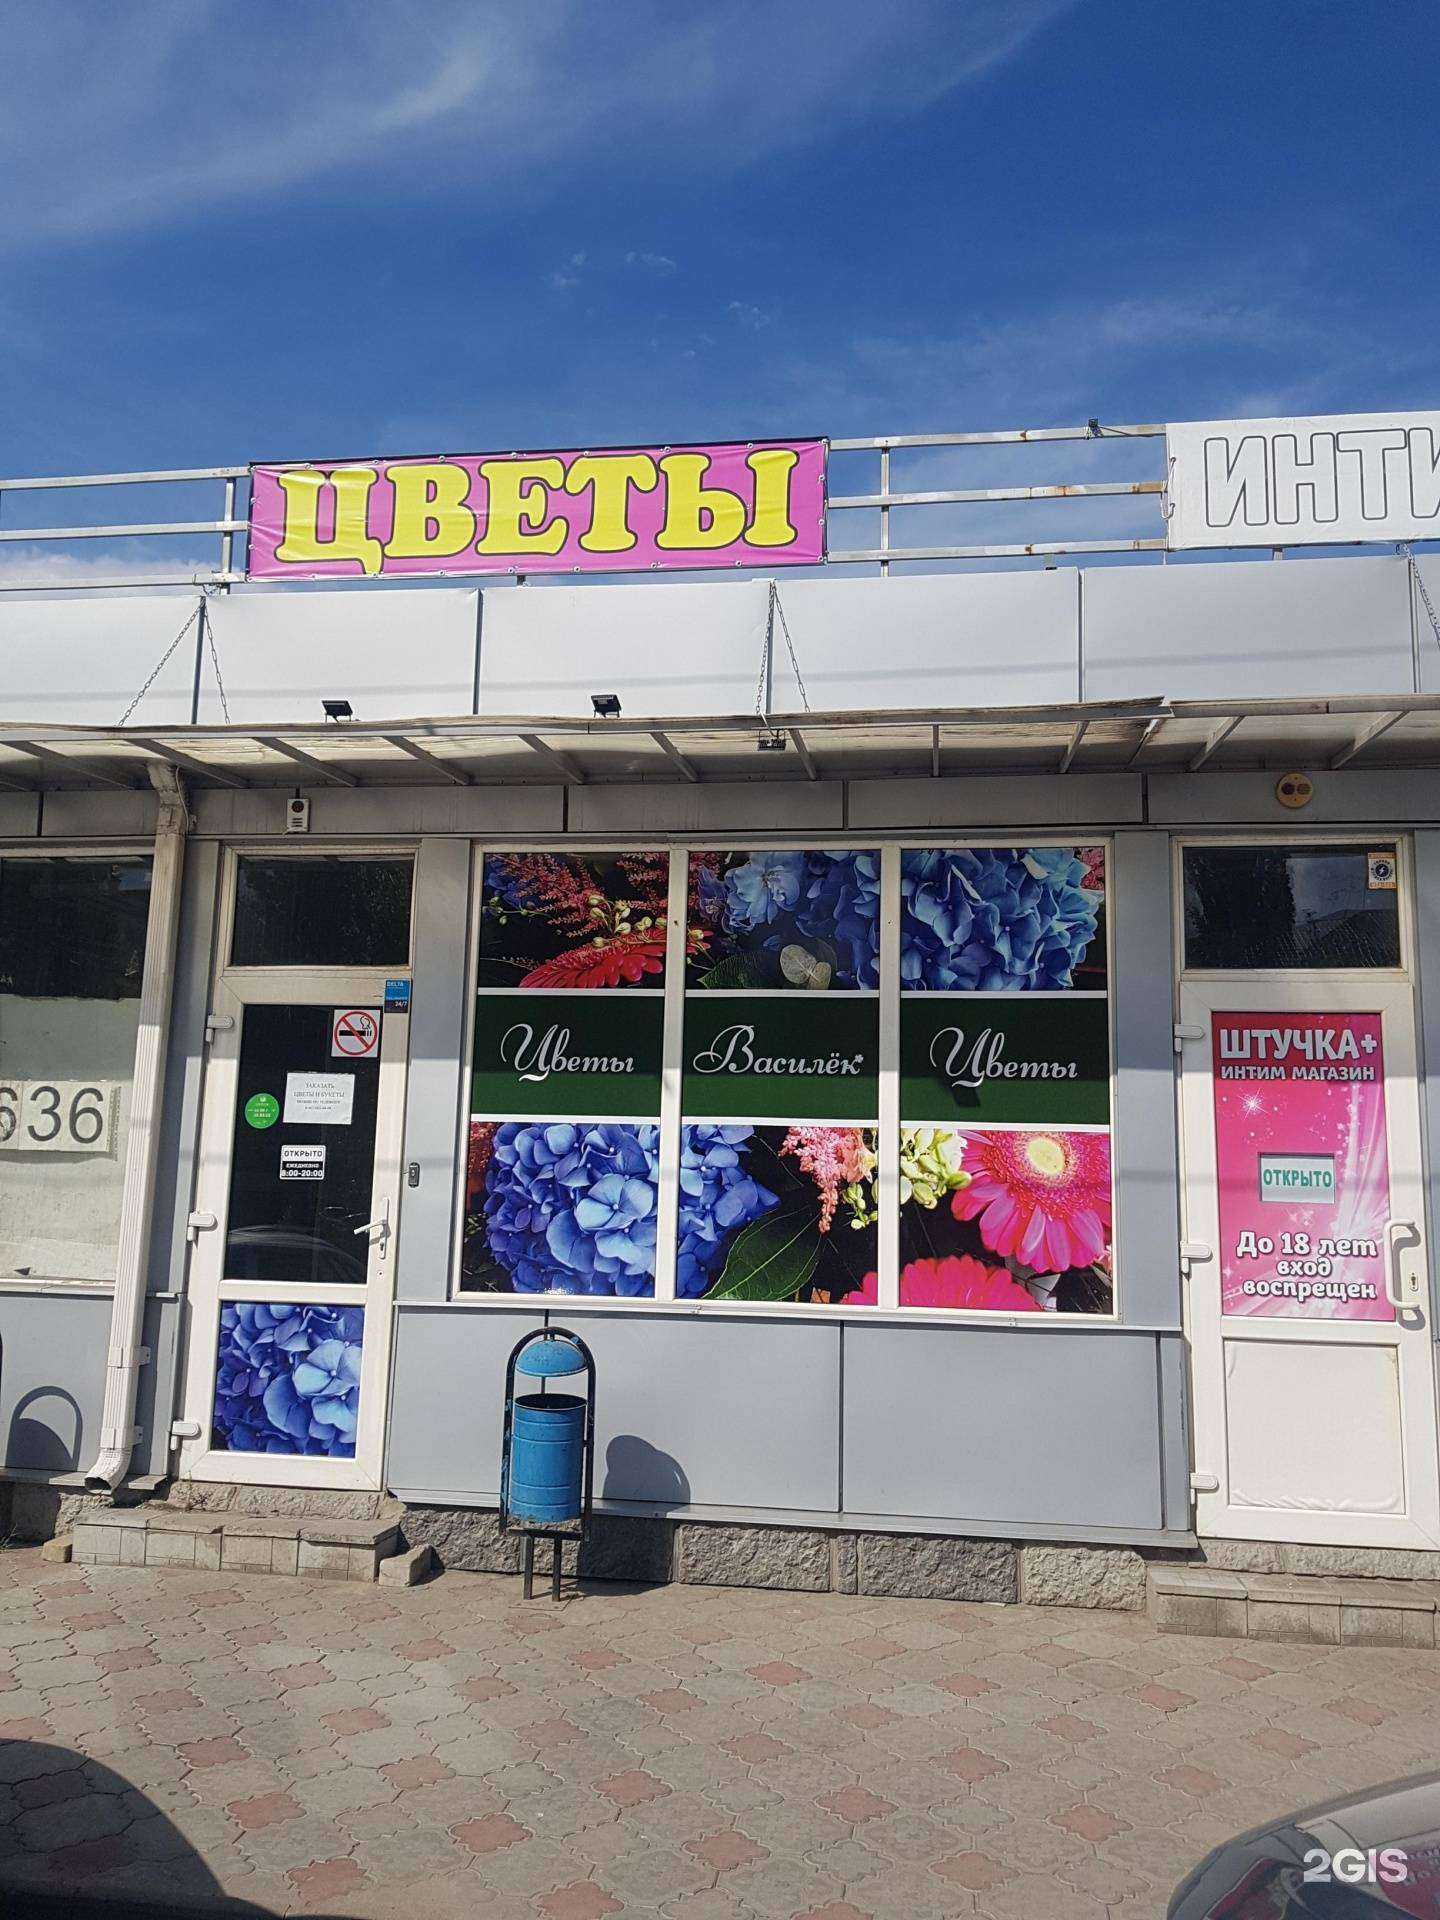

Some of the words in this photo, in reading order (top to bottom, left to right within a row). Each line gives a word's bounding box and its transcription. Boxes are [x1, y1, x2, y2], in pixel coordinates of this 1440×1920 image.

[274, 449, 798, 575] ЦВЕТЫ
[501, 1023, 634, 1082] Цветы
[930, 1027, 1079, 1088] Цветы
[1221, 1066, 1286, 1080] ИНТИМ
[1292, 1066, 1375, 1081] МАГАЗИН
[1263, 1169, 1333, 1188] ОТКРЫТО
[1236, 1231, 1274, 1258] До
[1281, 1232, 1310, 1255] 18
[1318, 1238, 1378, 1256] лет
[1276, 1257, 1332, 1277] вход
[1243, 1280, 1377, 1303] воспрещен
